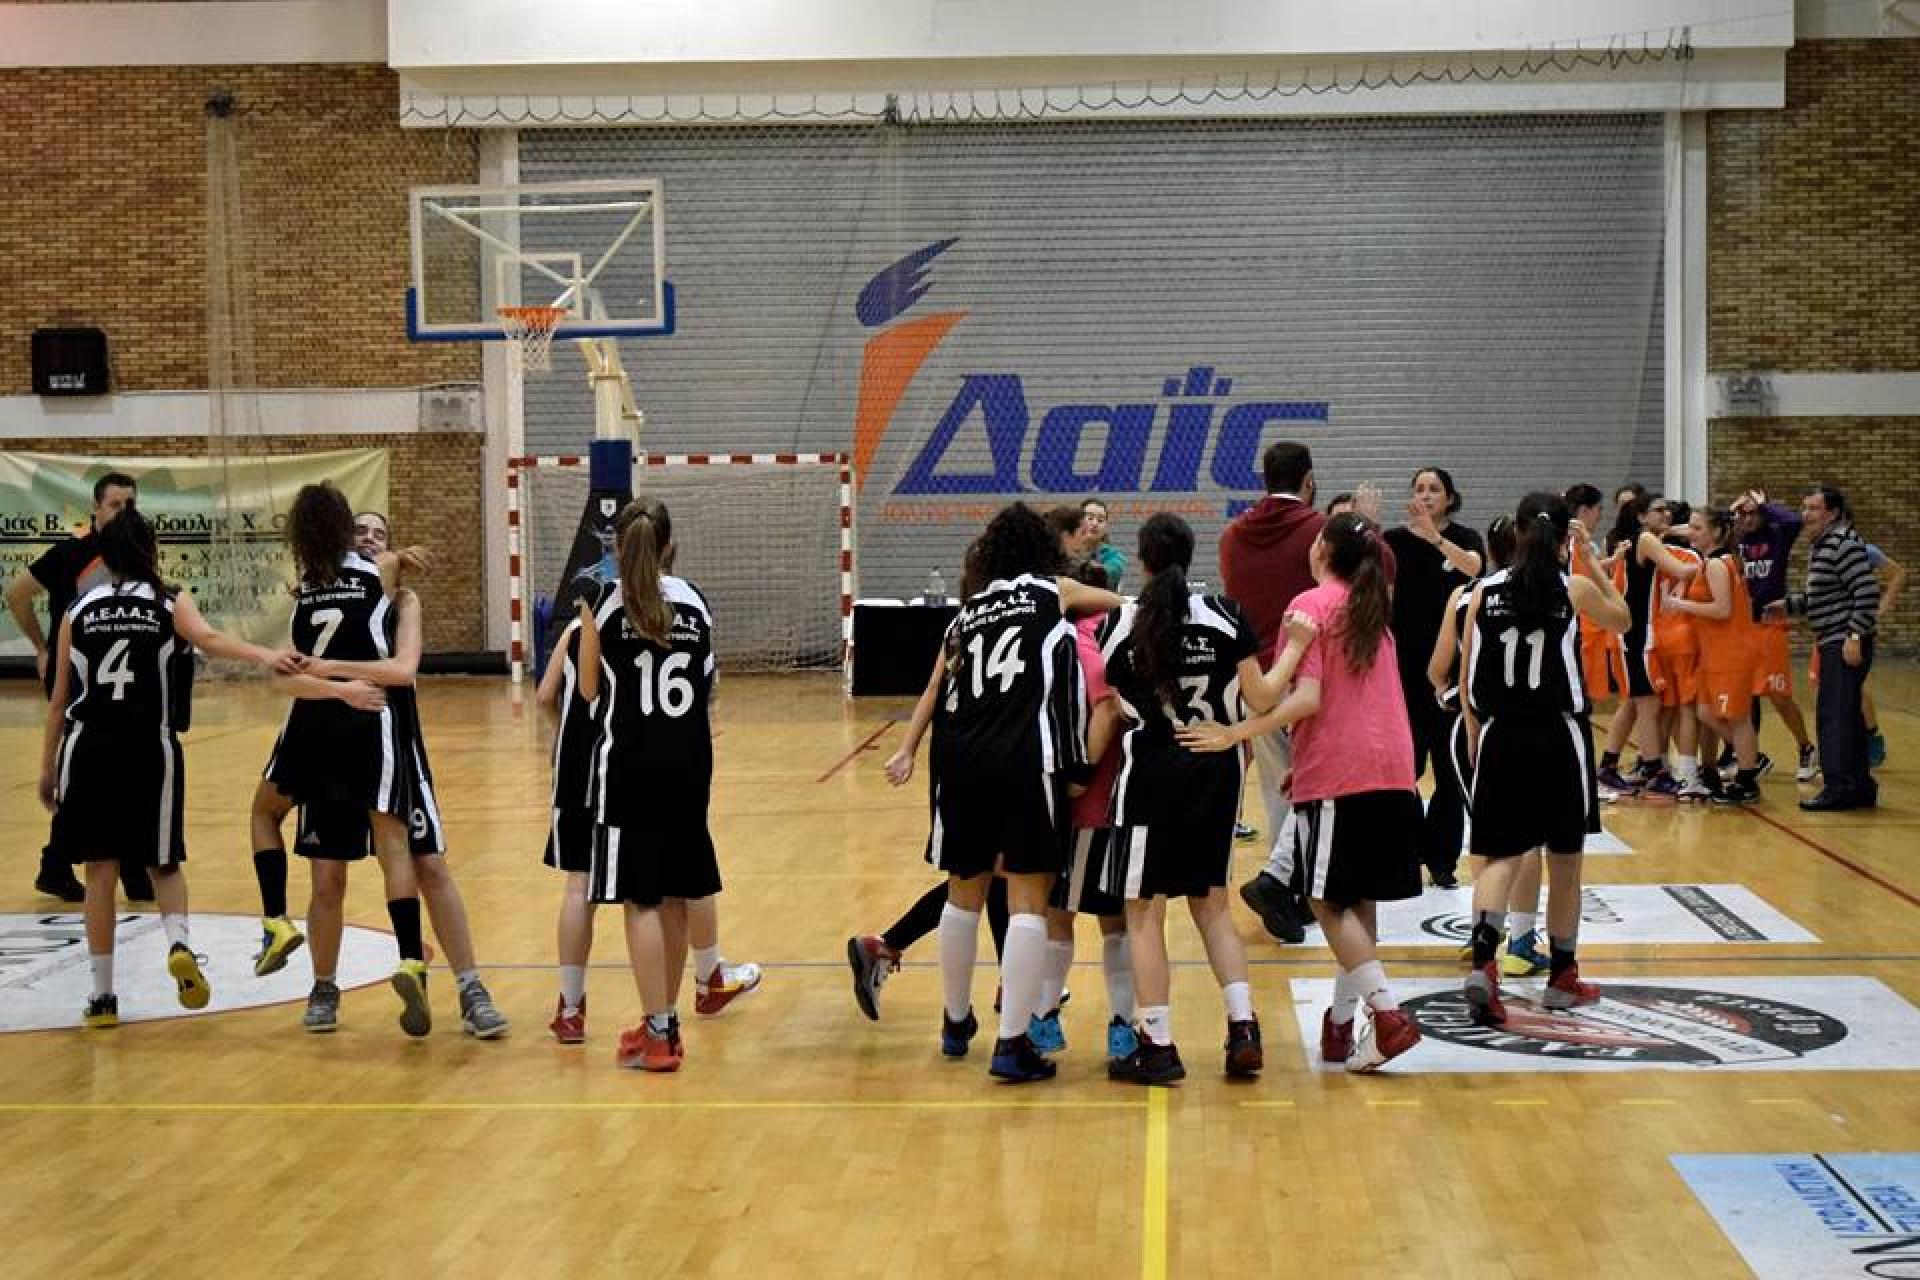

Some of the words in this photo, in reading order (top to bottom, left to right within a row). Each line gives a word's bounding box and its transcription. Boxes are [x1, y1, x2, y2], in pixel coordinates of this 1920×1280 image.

[0, 510, 39, 533] ιάς
[310, 608, 344, 657] 7
[967, 626, 1025, 698] 14
[1499, 626, 1545, 690] 11
[96, 638, 135, 700] 4
[634, 649, 695, 718] 16
[409, 807, 428, 840] 9
